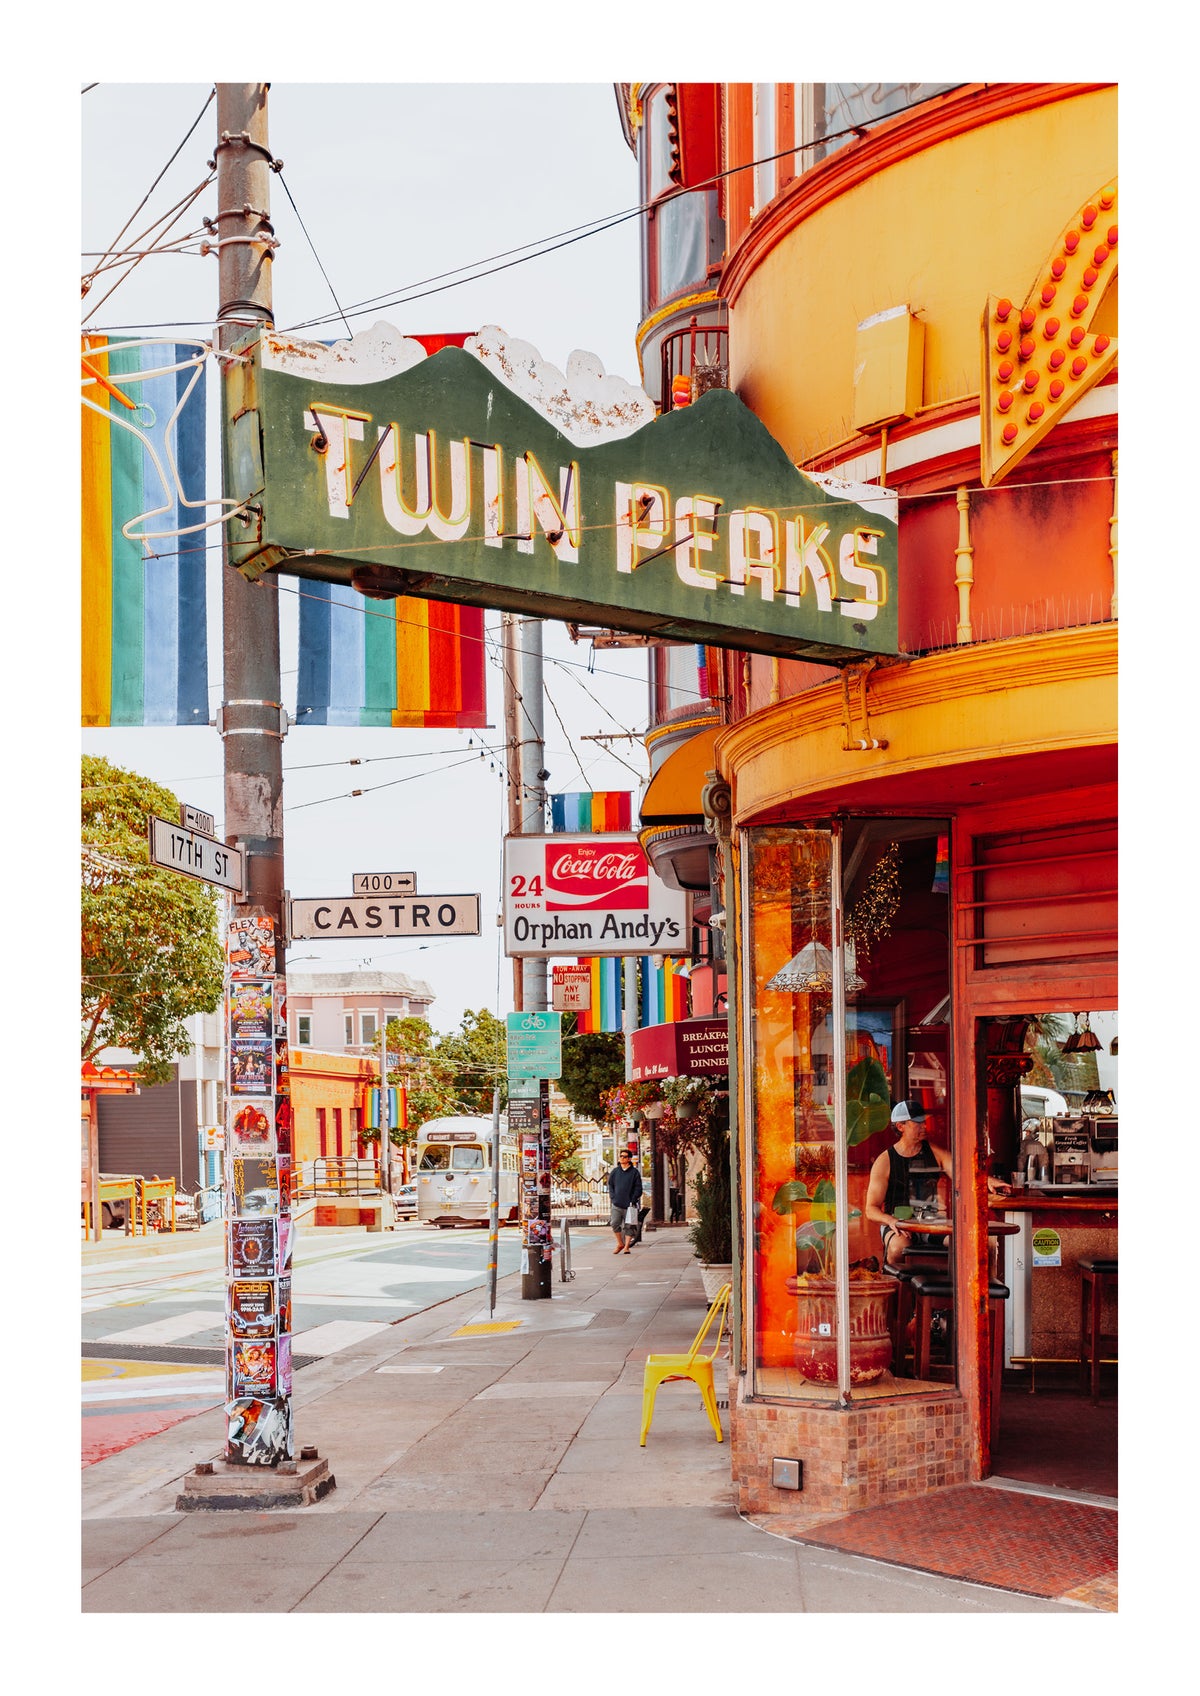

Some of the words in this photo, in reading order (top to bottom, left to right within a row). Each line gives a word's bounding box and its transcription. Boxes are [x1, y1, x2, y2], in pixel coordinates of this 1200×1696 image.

[304, 403, 582, 564] TWIN
[614, 481, 887, 621] PEAKS
[194, 812, 211, 832] 4000
[171, 833, 203, 869] 17TH
[214, 851, 229, 878] ST
[577, 848, 596, 857] Enjoy
[552, 853, 640, 880] Coca-Cola
[360, 875, 393, 891] 400
[510, 875, 544, 897] 24
[229, 918, 255, 932] FLEX
[314, 903, 457, 930] CASTRO
[514, 915, 592, 948] Orphan
[600, 913, 680, 947] Andy's
[553, 973, 564, 984] NO
[564, 974, 590, 984] STOPPING
[563, 994, 580, 1002] TIME
[564, 985, 579, 993] ANY
[1033, 1239, 1060, 1247] CAUTION
